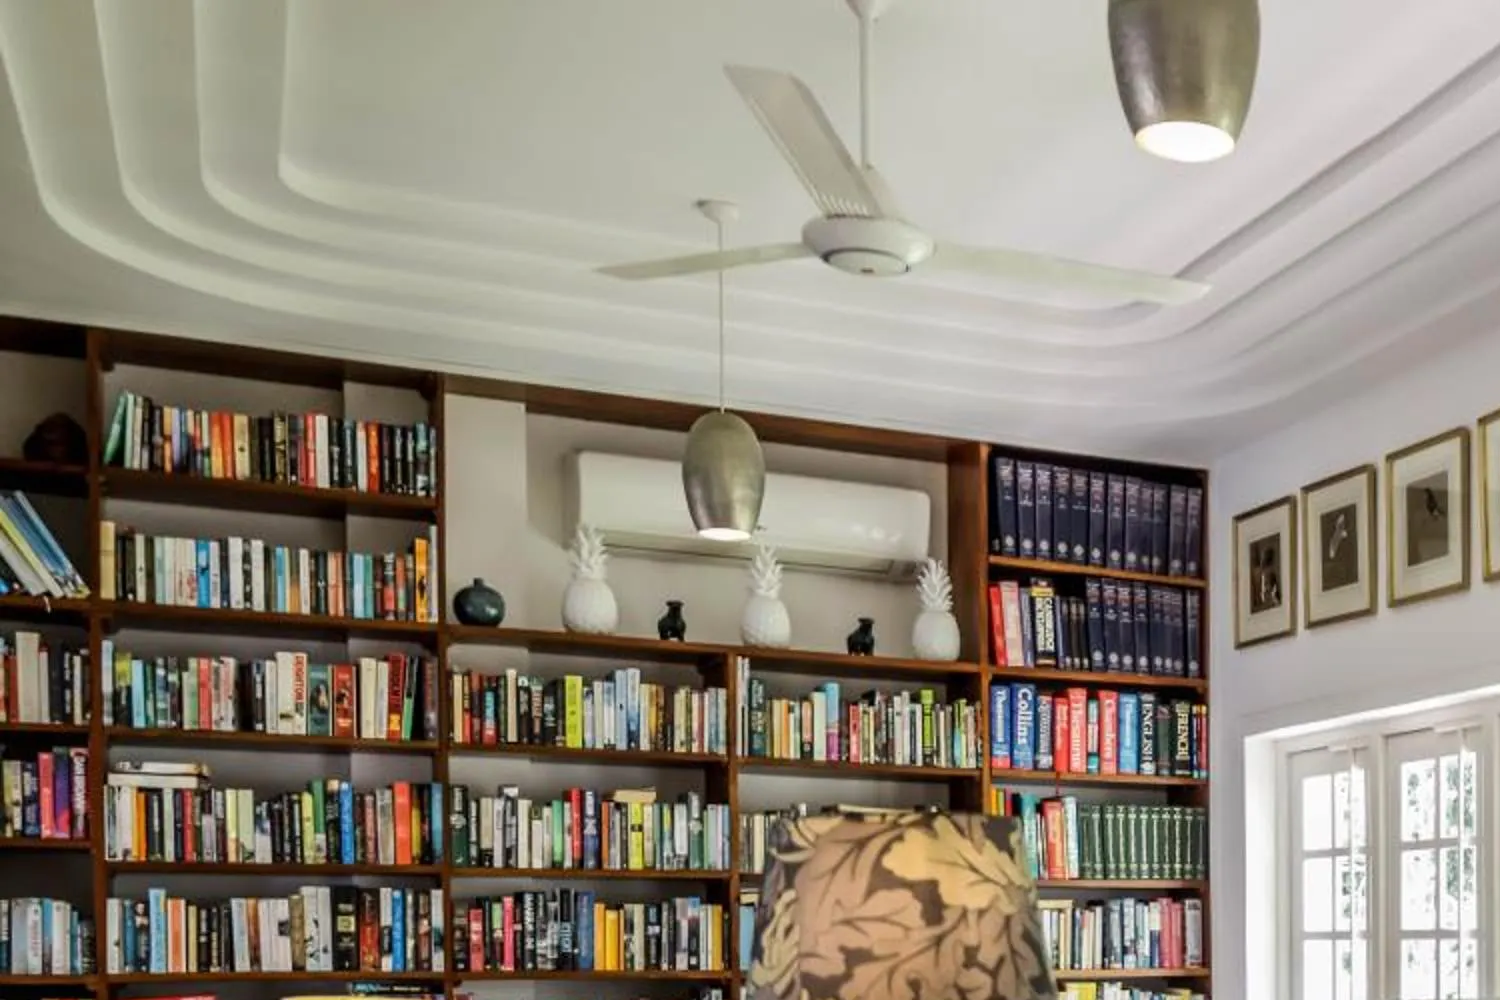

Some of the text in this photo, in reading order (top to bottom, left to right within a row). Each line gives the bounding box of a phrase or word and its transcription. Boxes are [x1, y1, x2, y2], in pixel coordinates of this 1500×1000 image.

[1017, 687, 1033, 745] Collins
[1142, 703, 1153, 760] ENGLISH
[1177, 713, 1189, 755] FRENCH
